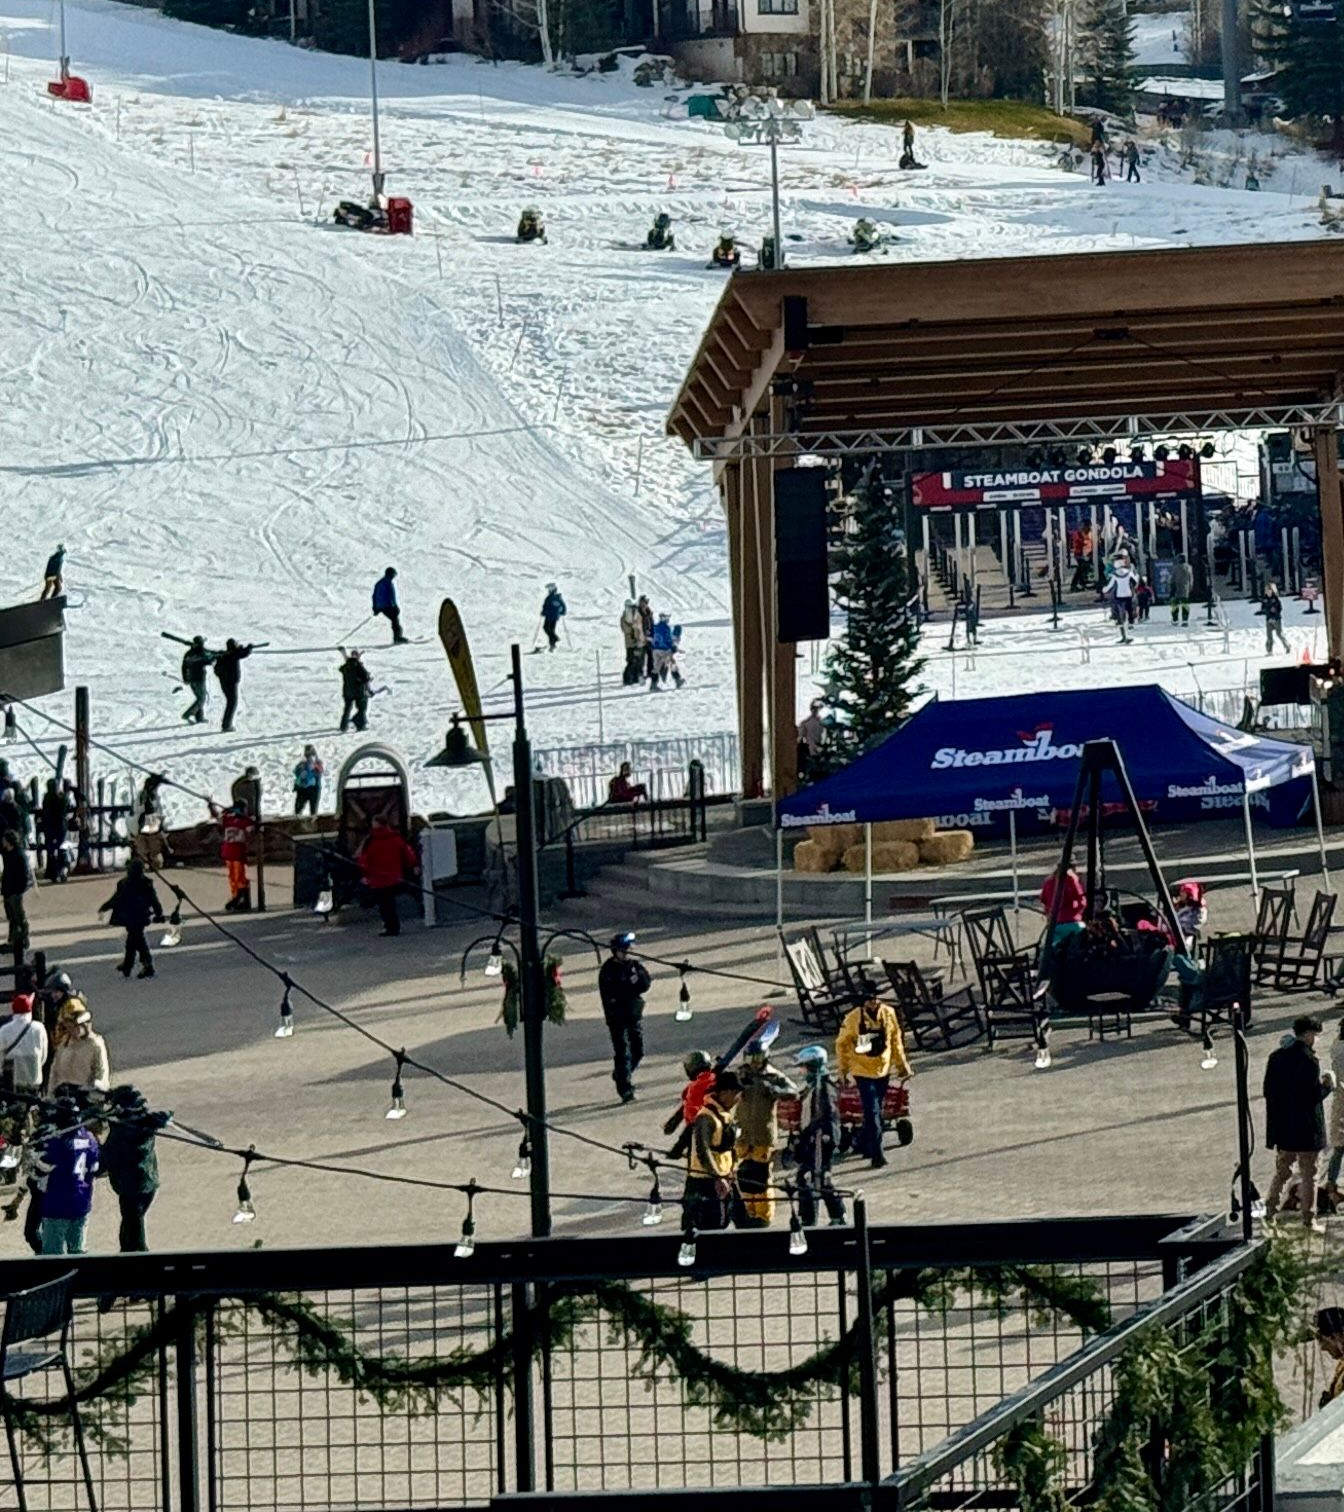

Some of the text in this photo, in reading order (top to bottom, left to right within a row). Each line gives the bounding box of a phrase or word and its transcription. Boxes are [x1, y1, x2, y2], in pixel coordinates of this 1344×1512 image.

[964, 465, 1144, 488] STEAMBOAT GONDOLA
[1167, 776, 1244, 799] Steamboat
[974, 788, 1050, 812] Steamboat
[781, 803, 857, 828] Steamboat
